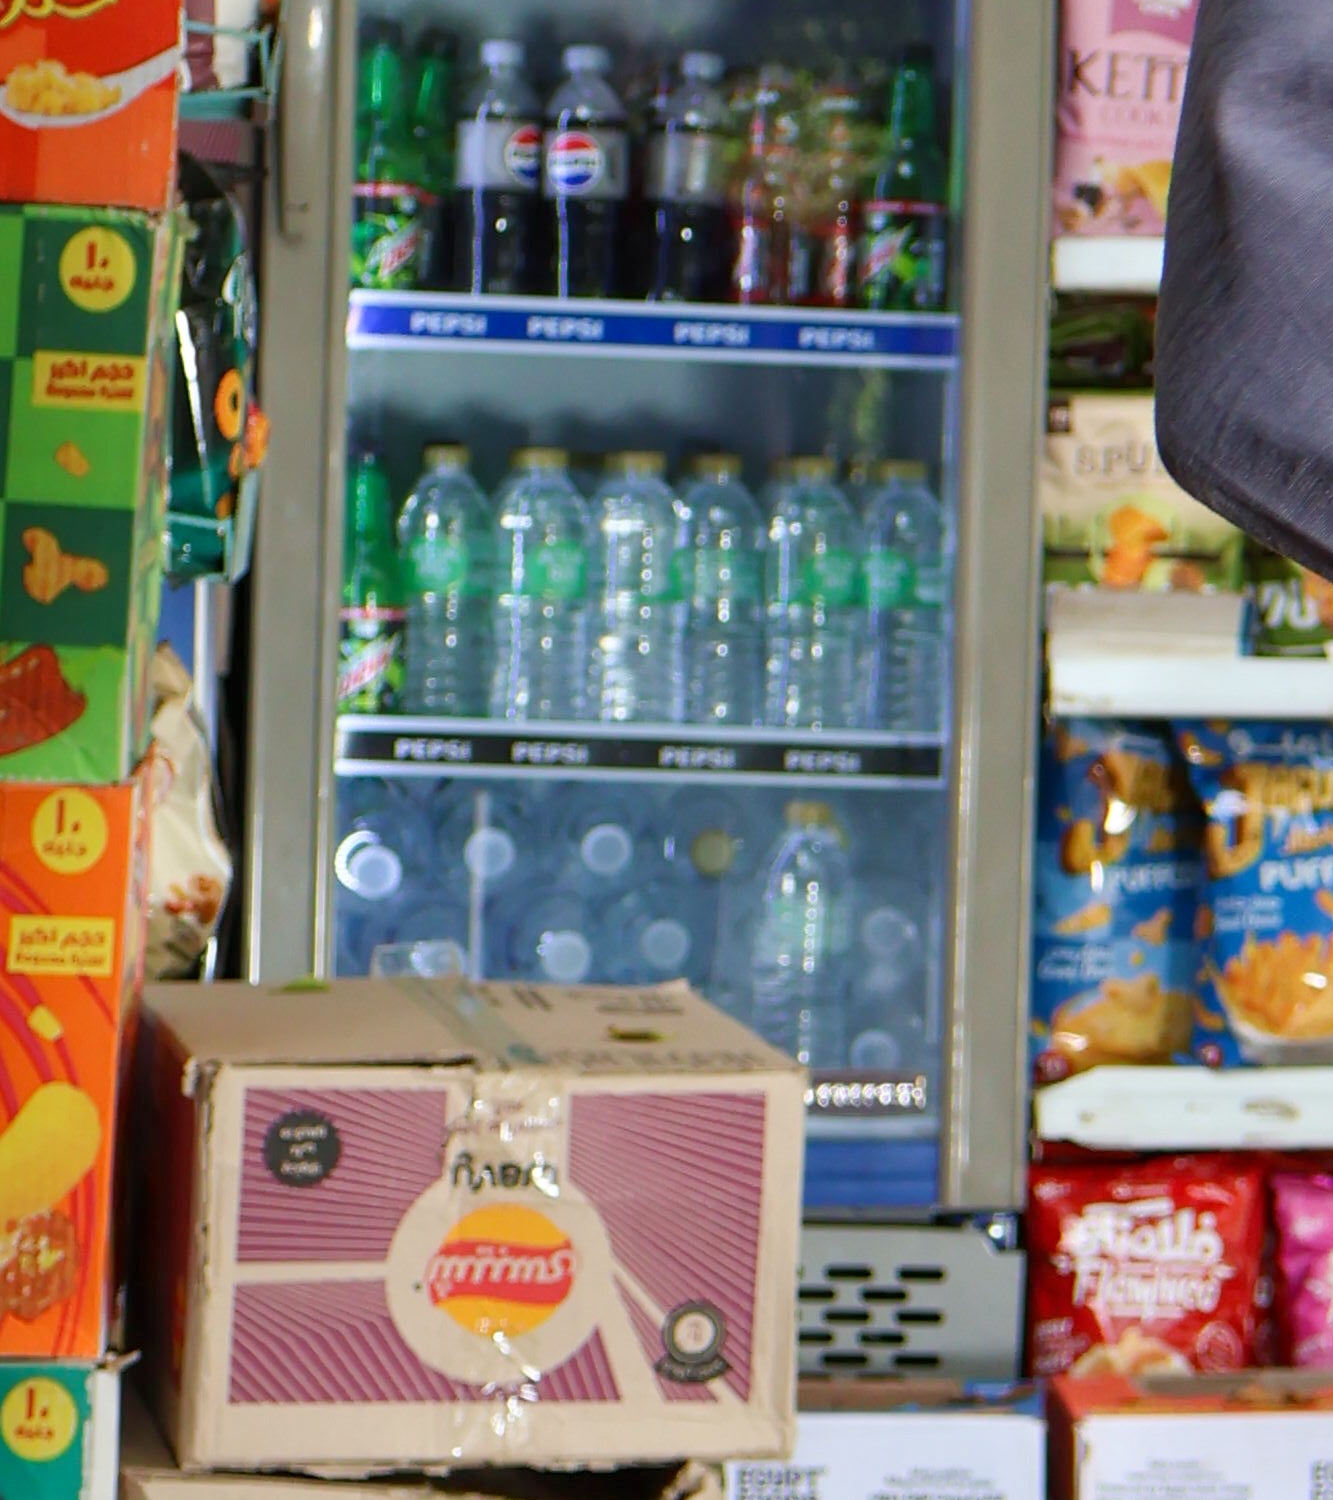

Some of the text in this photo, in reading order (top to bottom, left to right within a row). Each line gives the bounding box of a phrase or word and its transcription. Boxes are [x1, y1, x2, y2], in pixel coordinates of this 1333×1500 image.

[1066, 49, 1181, 105] KETT
[409, 311, 876, 352] PEPSI PEPSI PEPSI PEPSI
[394, 737, 861, 774] PEPSI PEPSI PEPSI PEPSI
